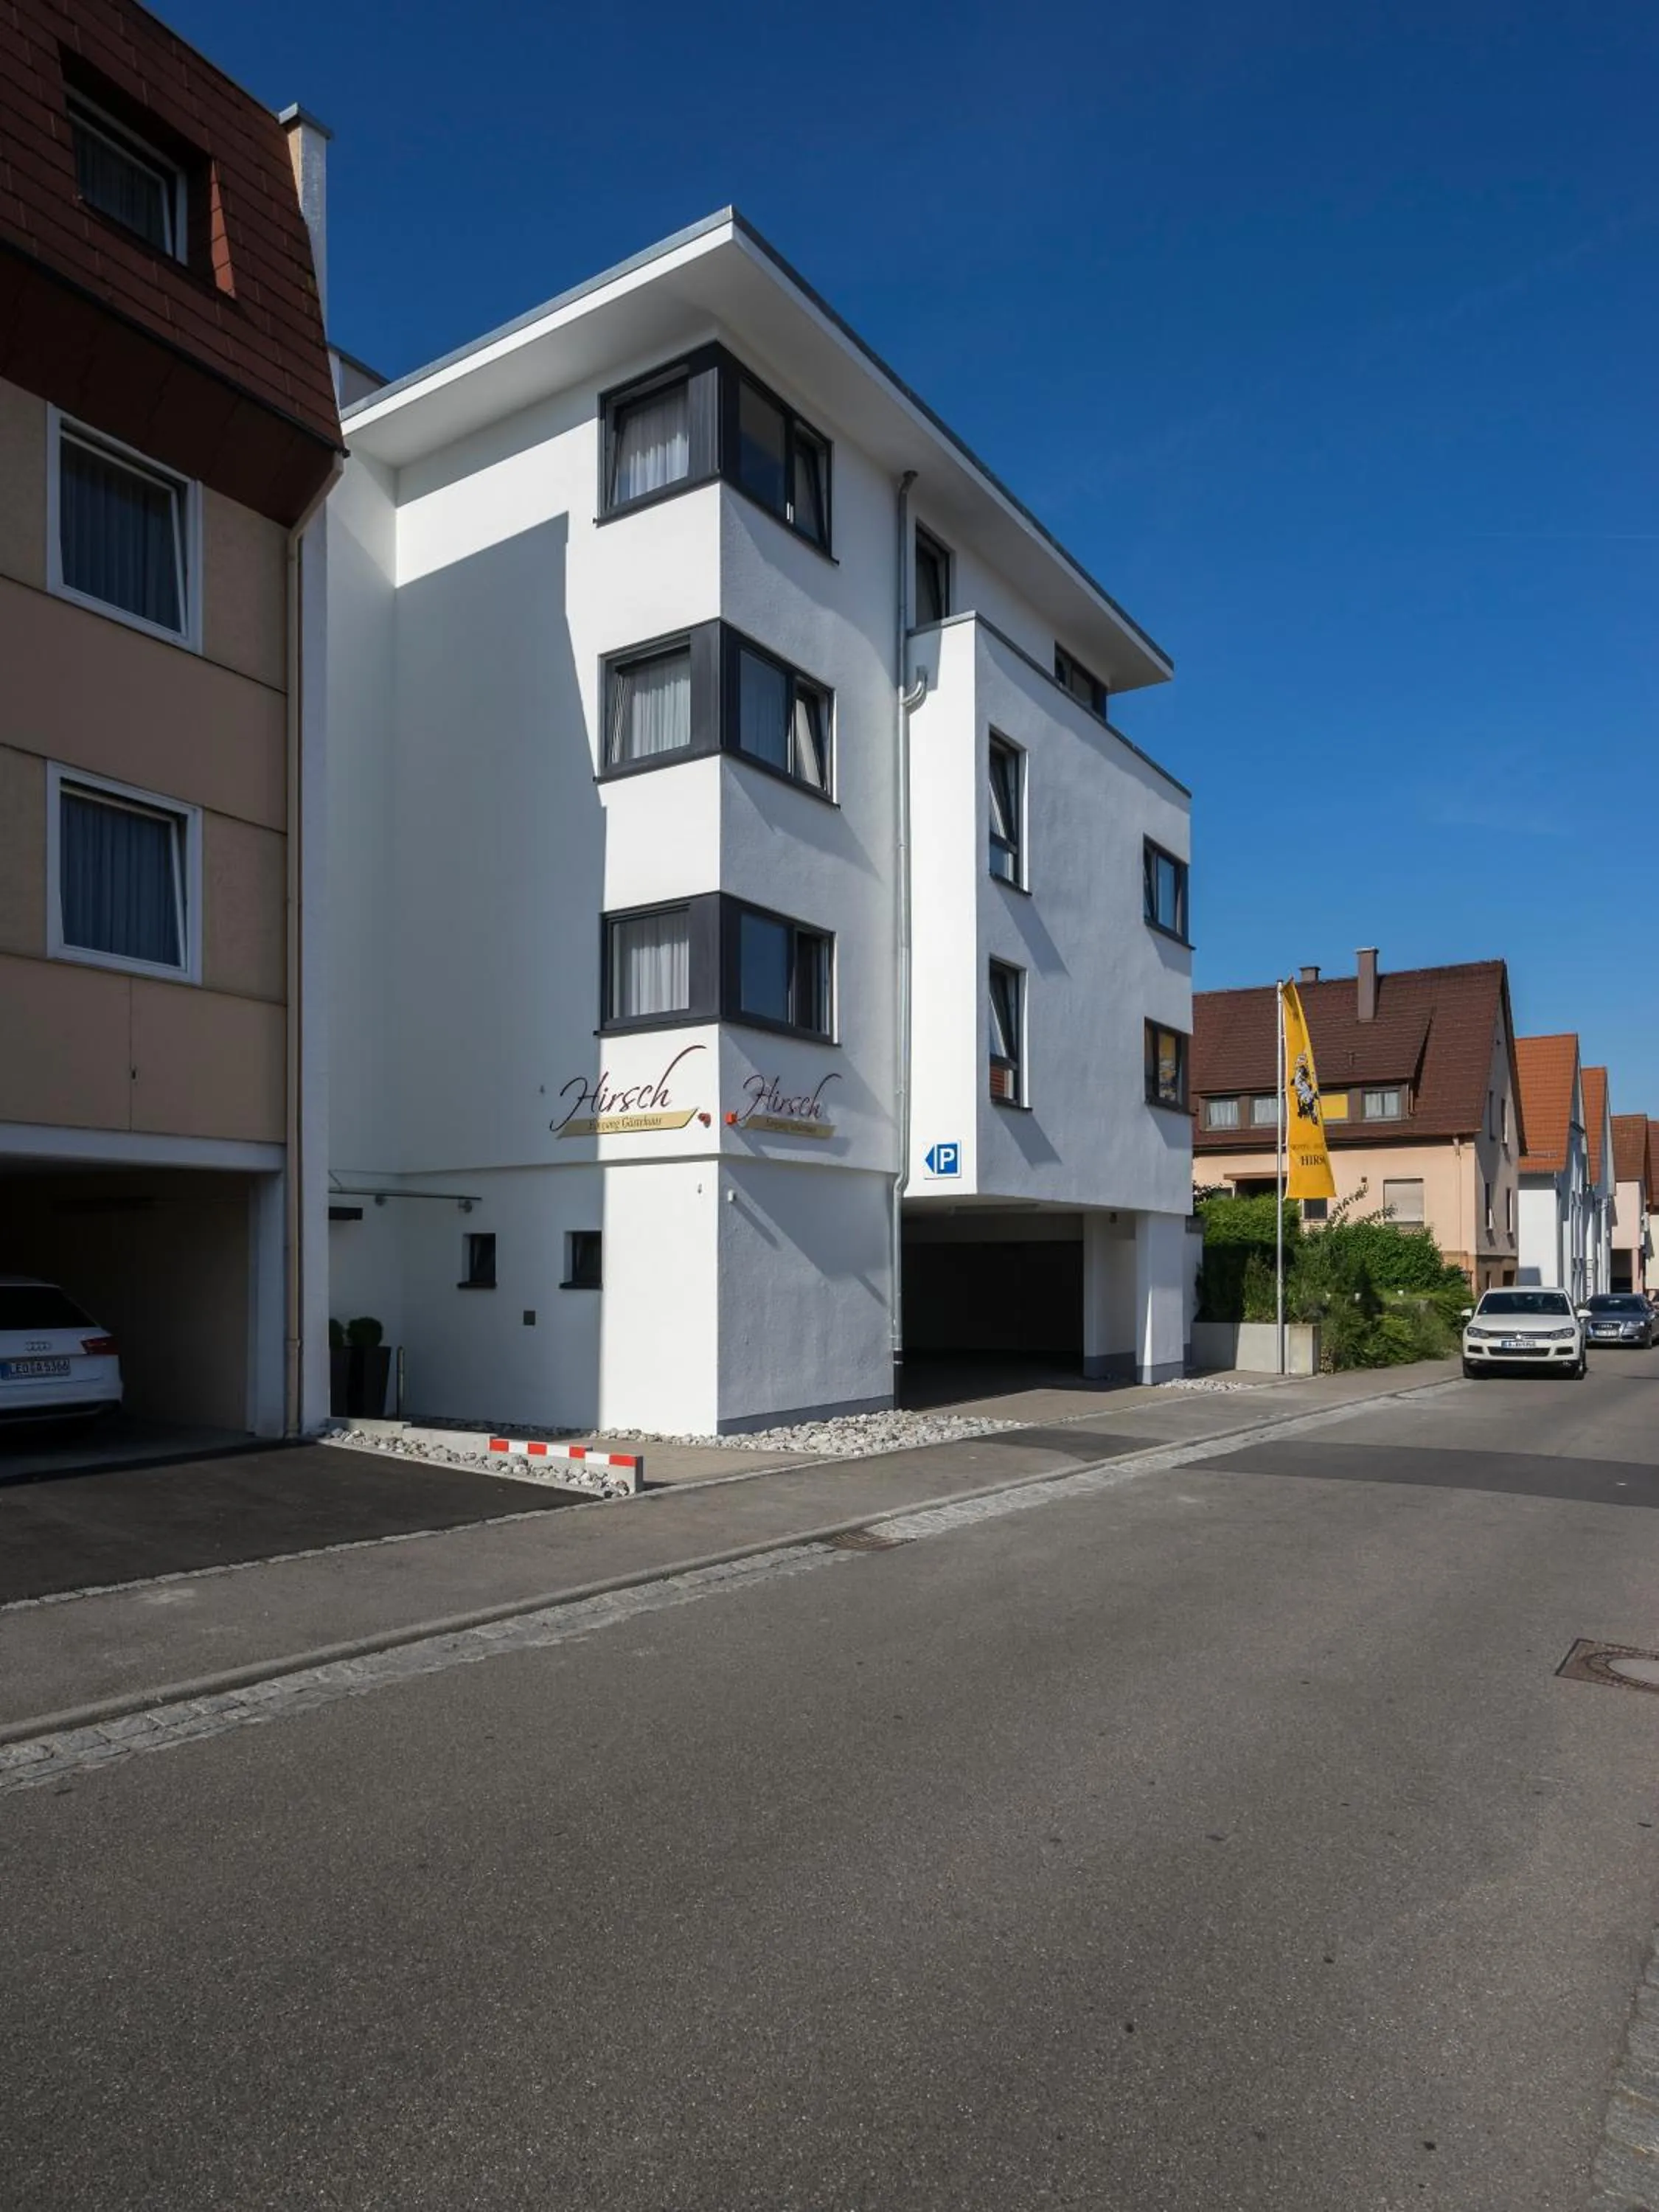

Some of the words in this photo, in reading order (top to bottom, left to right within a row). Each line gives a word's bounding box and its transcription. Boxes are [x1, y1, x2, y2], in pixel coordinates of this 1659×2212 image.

[550, 1045, 706, 1132] Hirsch
[736, 1073, 842, 1122] Hirsch
[939, 1148, 955, 1170] P
